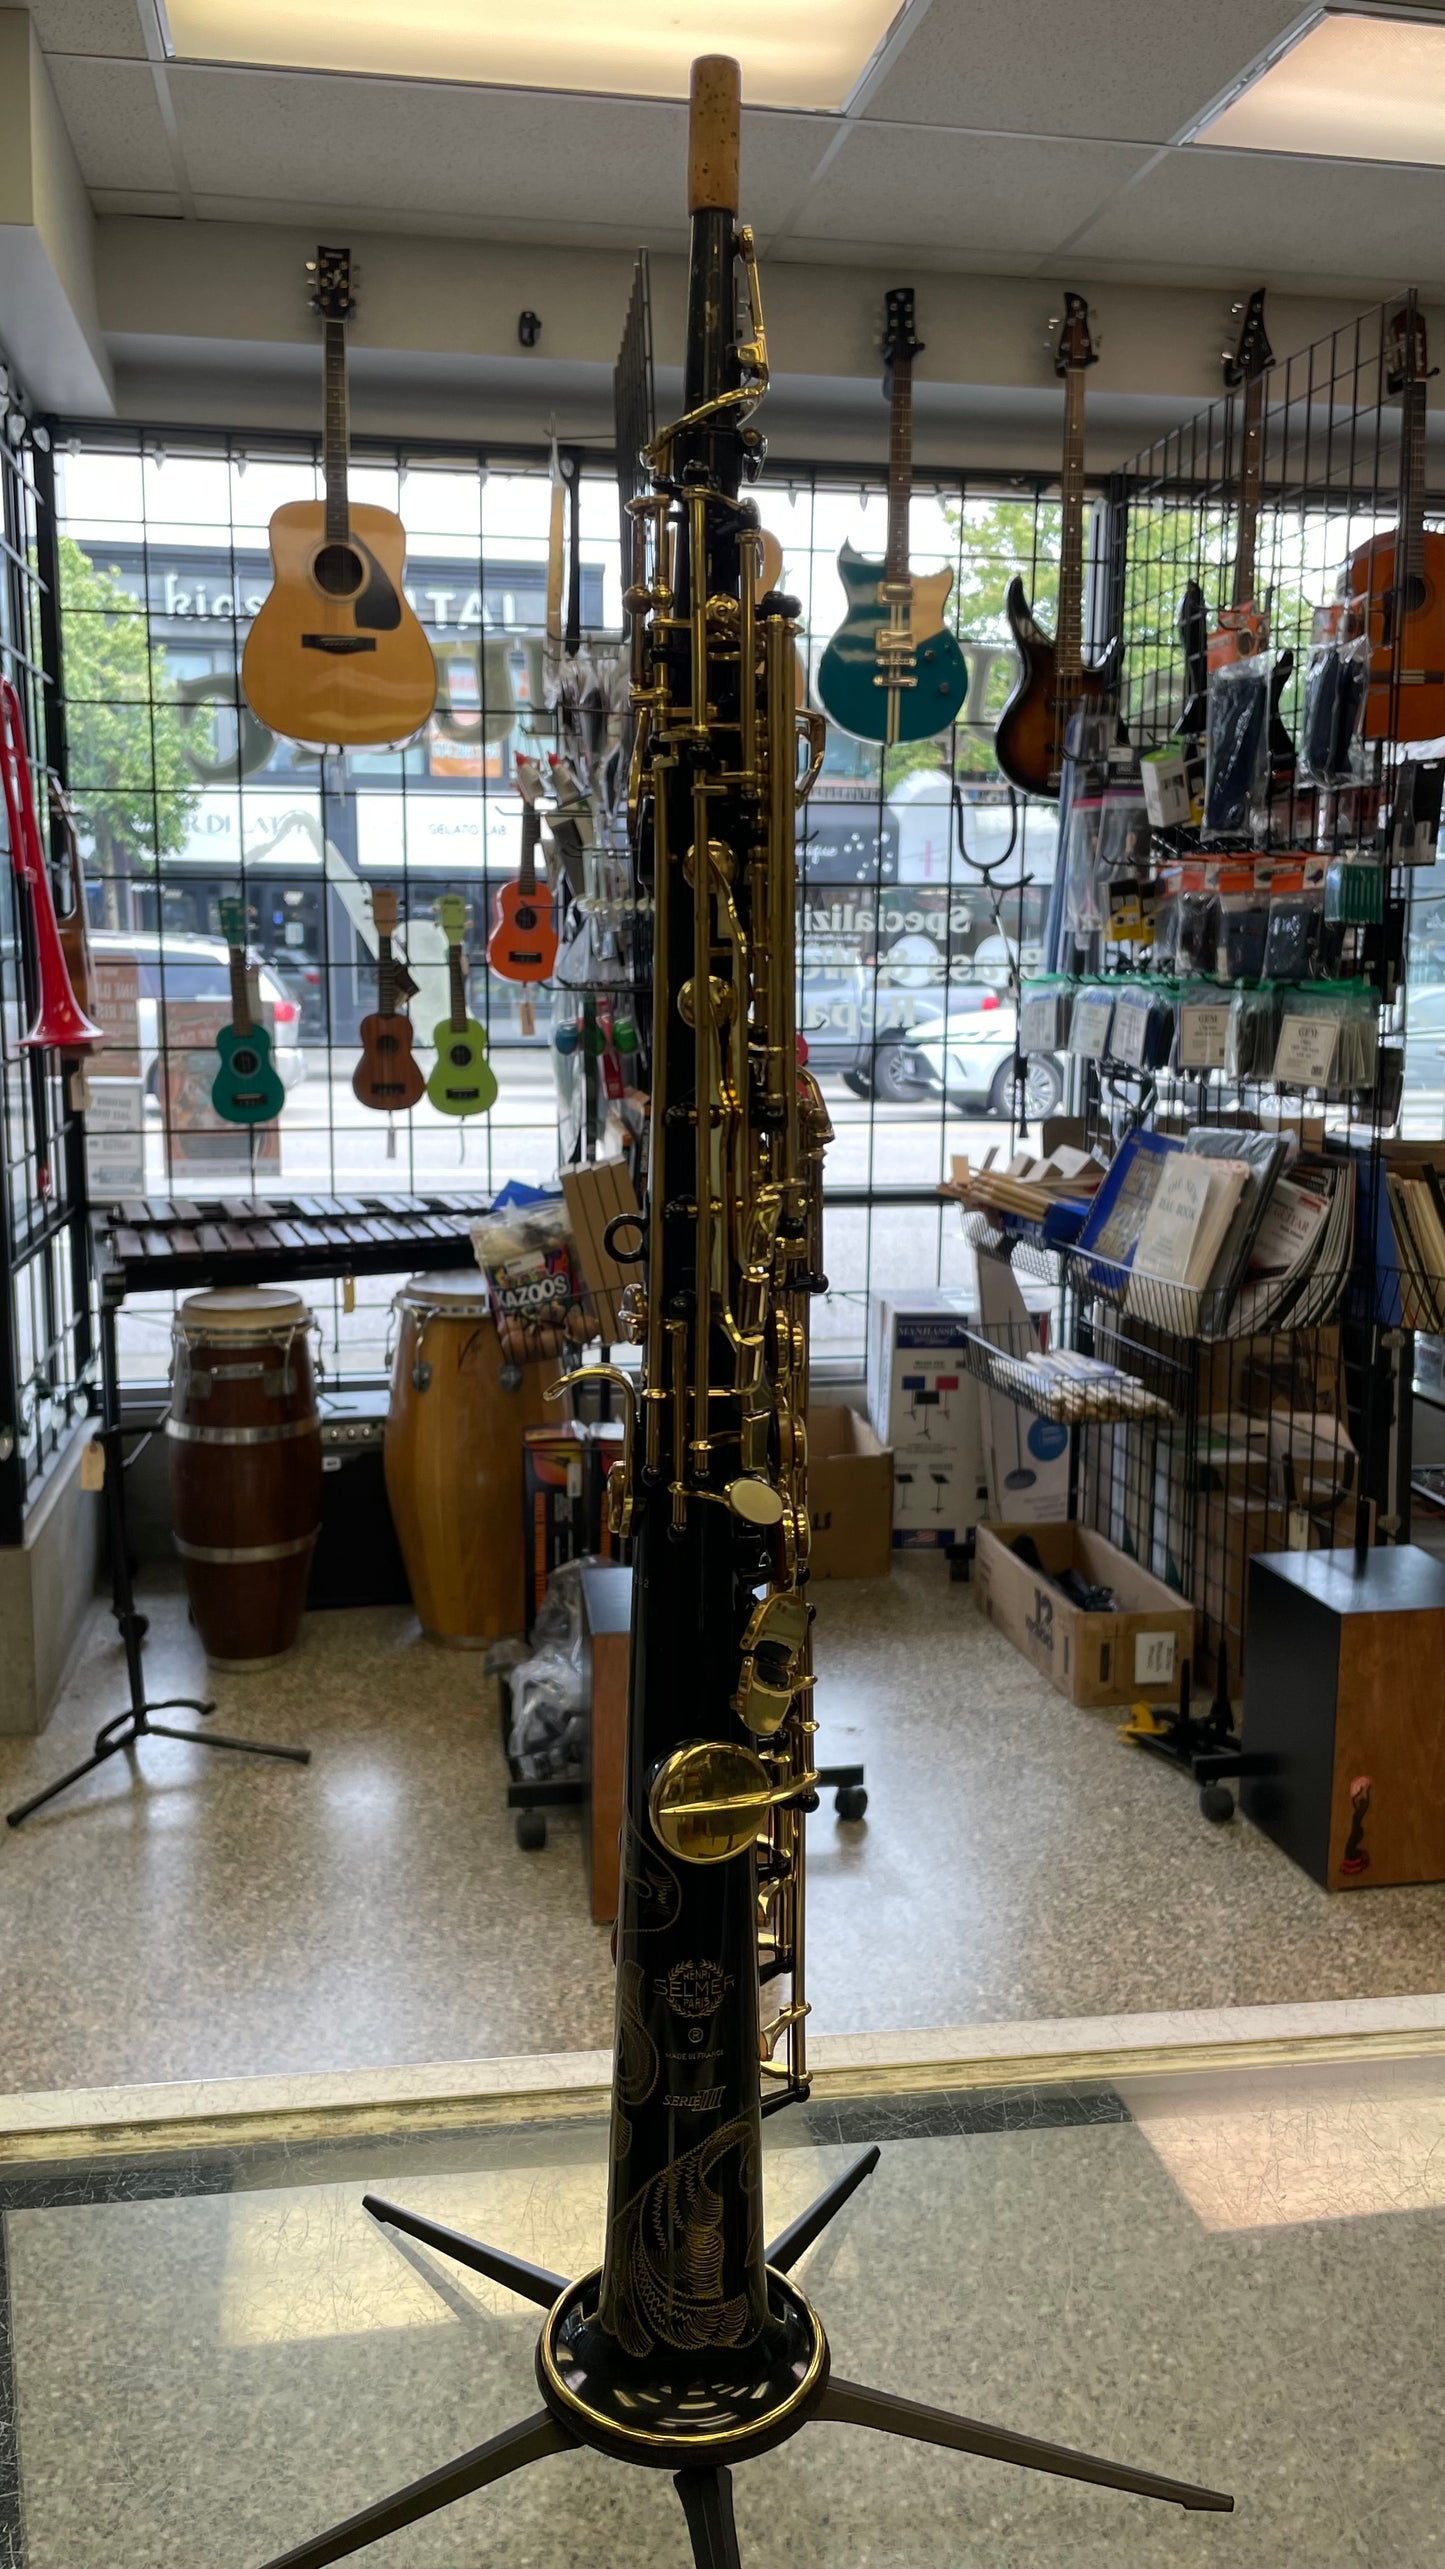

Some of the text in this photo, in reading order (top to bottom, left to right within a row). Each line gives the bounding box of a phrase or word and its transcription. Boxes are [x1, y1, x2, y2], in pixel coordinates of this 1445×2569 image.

[165, 572, 529, 631] kids TAL
[494, 1274, 568, 1309] KAZOOS
[683, 1969, 711, 1981] HENRI
[652, 1974, 736, 1998] SELMER
[683, 1997, 710, 2010] PARIS
[697, 2049, 725, 2060] FRANCE
